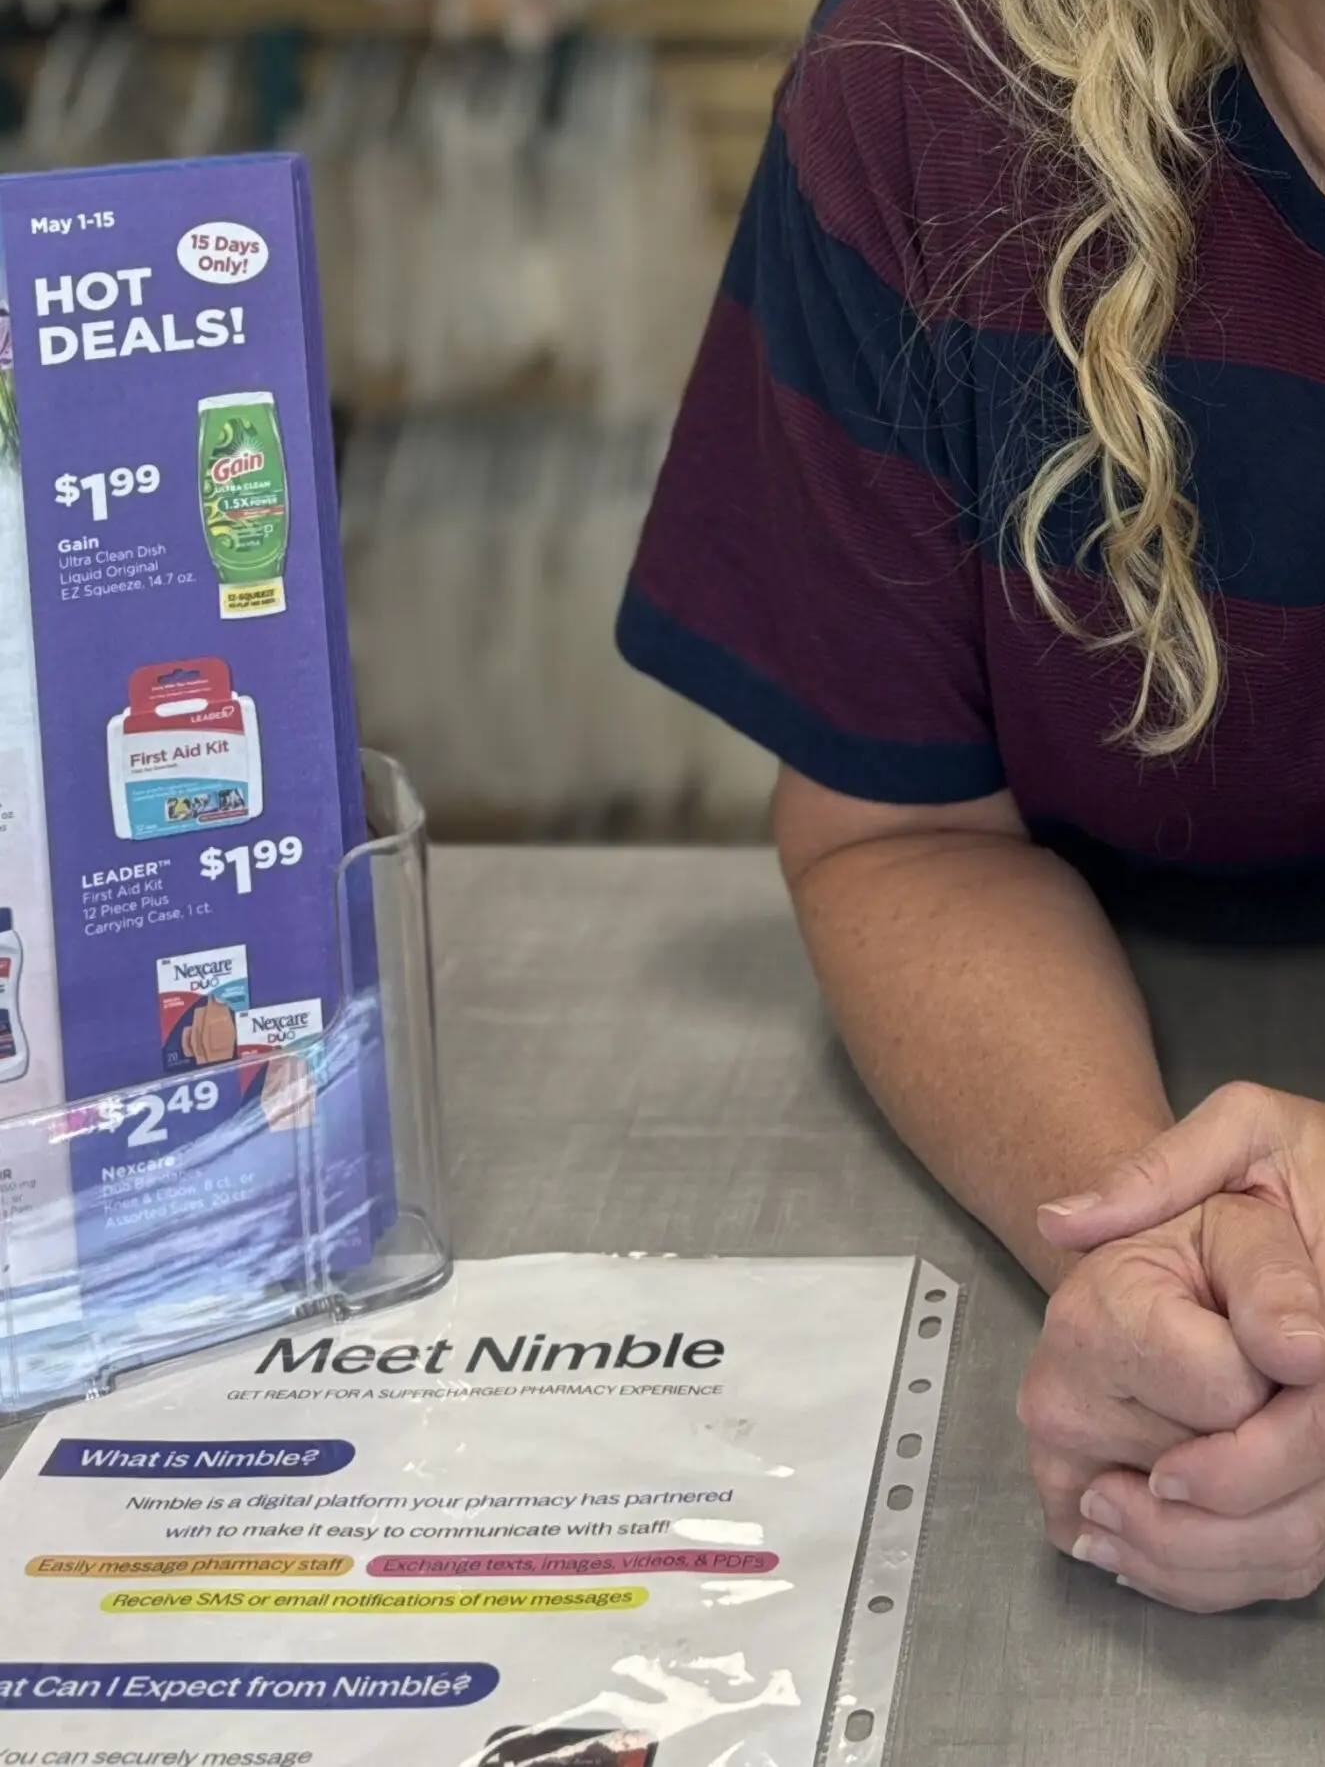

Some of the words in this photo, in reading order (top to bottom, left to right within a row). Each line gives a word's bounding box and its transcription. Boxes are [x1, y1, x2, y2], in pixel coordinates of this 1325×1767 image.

[30, 215, 72, 235] May
[77, 210, 115, 230] 1-15
[190, 234, 210, 250] 15
[214, 235, 260, 256] Days
[198, 255, 248, 276] Only!
[34, 267, 152, 317] HOT
[38, 306, 245, 366] DEALS!
[211, 451, 264, 484] Gain
[57, 535, 100, 553] Gain
[58, 554, 92, 570] Ultra
[95, 549, 134, 565] Clean
[137, 543, 167, 559] Dish
[59, 568, 102, 586] Liquid
[106, 560, 159, 578] Original
[61, 586, 81, 601] EZ
[148, 572, 174, 588] 14.7
[129, 749, 168, 769] First
[172, 743, 201, 761] Aid
[206, 740, 230, 756] Kit
[82, 888, 113, 905] First
[116, 882, 141, 899] Aid
[144, 878, 164, 893] Kit
[83, 907, 97, 921] 12
[101, 900, 138, 918] Piece
[141, 891, 170, 907] Plus
[84, 914, 144, 937] Carrying
[187, 903, 193, 916] 1
[174, 958, 233, 982] Nexcare
[190, 977, 219, 991] DUO
[252, 1010, 310, 1034] Nexcare
[267, 1030, 296, 1044] DUO
[101, 1155, 176, 1182] Nexcare
[254, 1336, 454, 1374] Meet
[464, 1332, 725, 1373] Nimble
[227, 1389, 261, 1401] GET
[263, 1389, 321, 1400] READY
[324, 1388, 359, 1400] FOR
[354, 1388, 374, 1399] A
[378, 1386, 518, 1399] SUPERCHARGED
[520, 1385, 616, 1396] PHARMACY
[619, 1385, 725, 1396] EXPERIENCE
[81, 1448, 161, 1469] What
[163, 1449, 188, 1469] is
[194, 1448, 320, 1469] Nimble?
[126, 1496, 203, 1511] Nimble
[206, 1496, 226, 1510] is
[228, 1498, 243, 1509] a
[247, 1493, 314, 1514] digital
[314, 1492, 407, 1511] platform
[410, 1495, 460, 1512] your
[464, 1492, 576, 1511] pharmacy
[581, 1492, 621, 1507] has
[624, 1489, 734, 1509] partnered
[165, 1524, 211, 1540] with
[216, 1524, 240, 1538] to
[243, 1523, 305, 1538] make
[308, 1523, 324, 1538] it
[326, 1525, 379, 1541] easy
[382, 1525, 405, 1539] to
[409, 1524, 562, 1539] communicate
[567, 1521, 612, 1536] with
[617, 1520, 671, 1535] staff!
[37, 1558, 96, 1575] Easily
[98, 1559, 189, 1575] message
[191, 1557, 298, 1574] pharmacy
[300, 1558, 345, 1572] staff
[383, 1557, 482, 1575] Exchange
[486, 1558, 538, 1573] texts,
[694, 1554, 708, 1567] &
[713, 1553, 765, 1569] PDFs
[112, 1592, 194, 1608] Receive
[196, 1592, 245, 1607] SMS
[248, 1594, 272, 1607] or
[273, 1592, 330, 1607] email
[332, 1592, 456, 1608] notifications
[459, 1592, 482, 1608] of
[483, 1594, 529, 1607] new
[530, 1591, 633, 1608] messages
[32, 1675, 102, 1698] Can
[105, 1676, 120, 1698] I
[122, 1675, 242, 1703] Expect
[246, 1674, 329, 1698] from
[332, 1673, 472, 1698] Nimble?
[41, 1750, 90, 1766] can
[92, 1749, 200, 1767] securely
[201, 1748, 313, 1767] message
